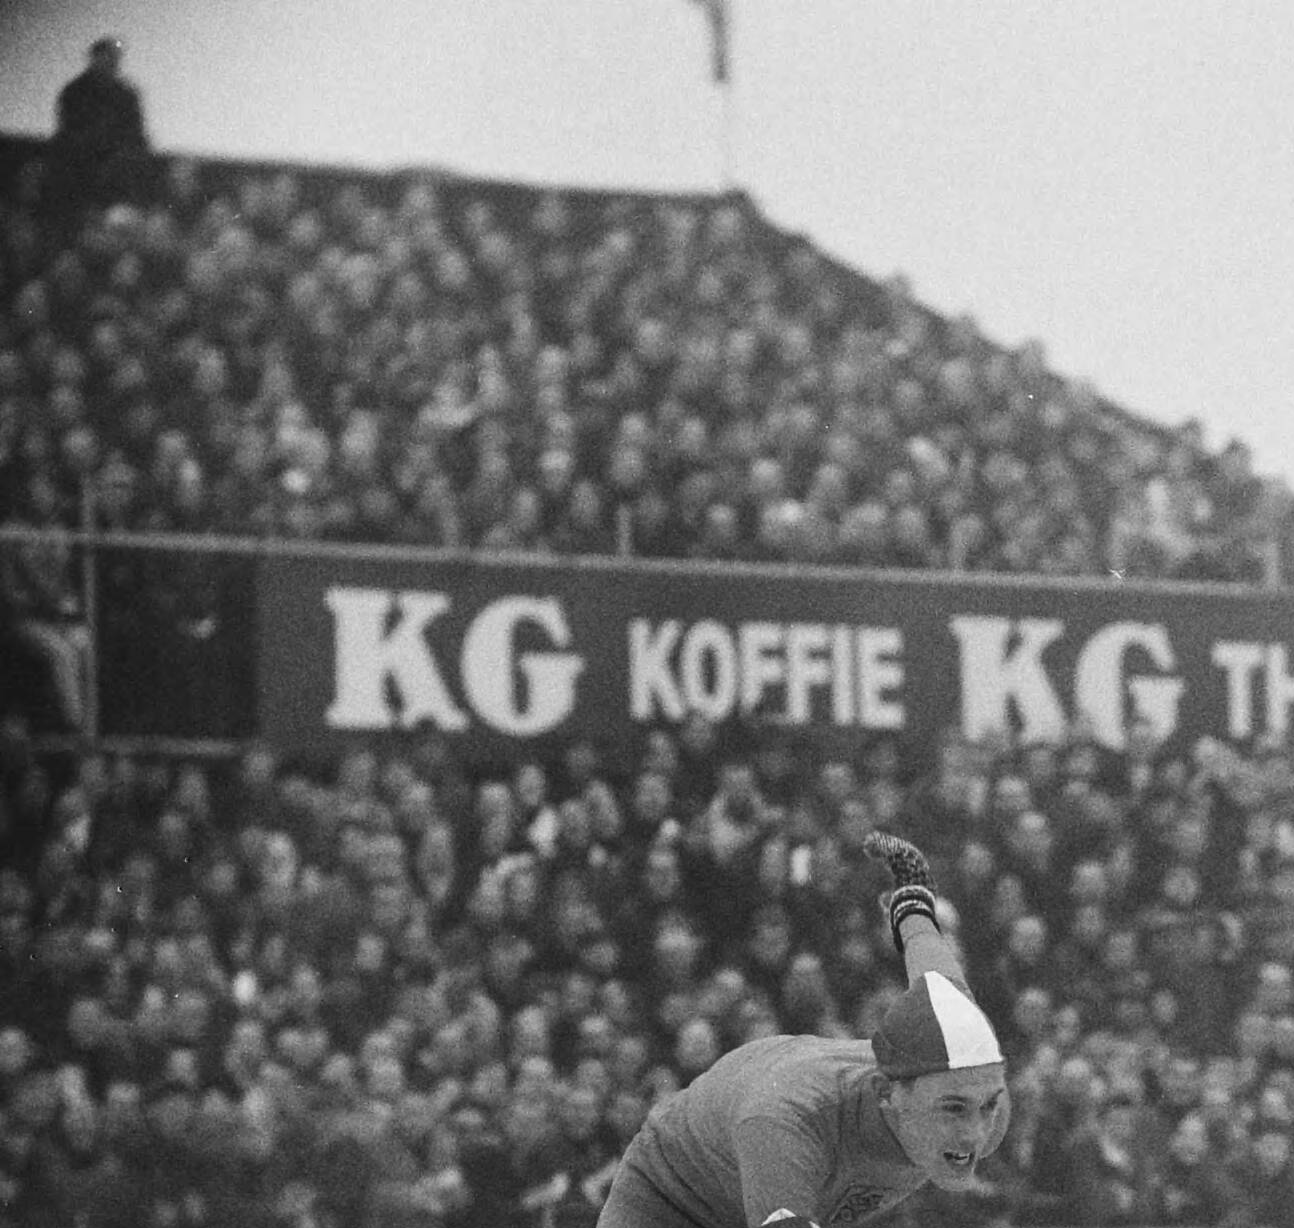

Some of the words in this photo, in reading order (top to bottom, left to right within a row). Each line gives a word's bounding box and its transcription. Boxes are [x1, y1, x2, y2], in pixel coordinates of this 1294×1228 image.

[324, 586, 585, 736] KG
[629, 618, 905, 730] KOFFIE
[950, 615, 1185, 749] KG
